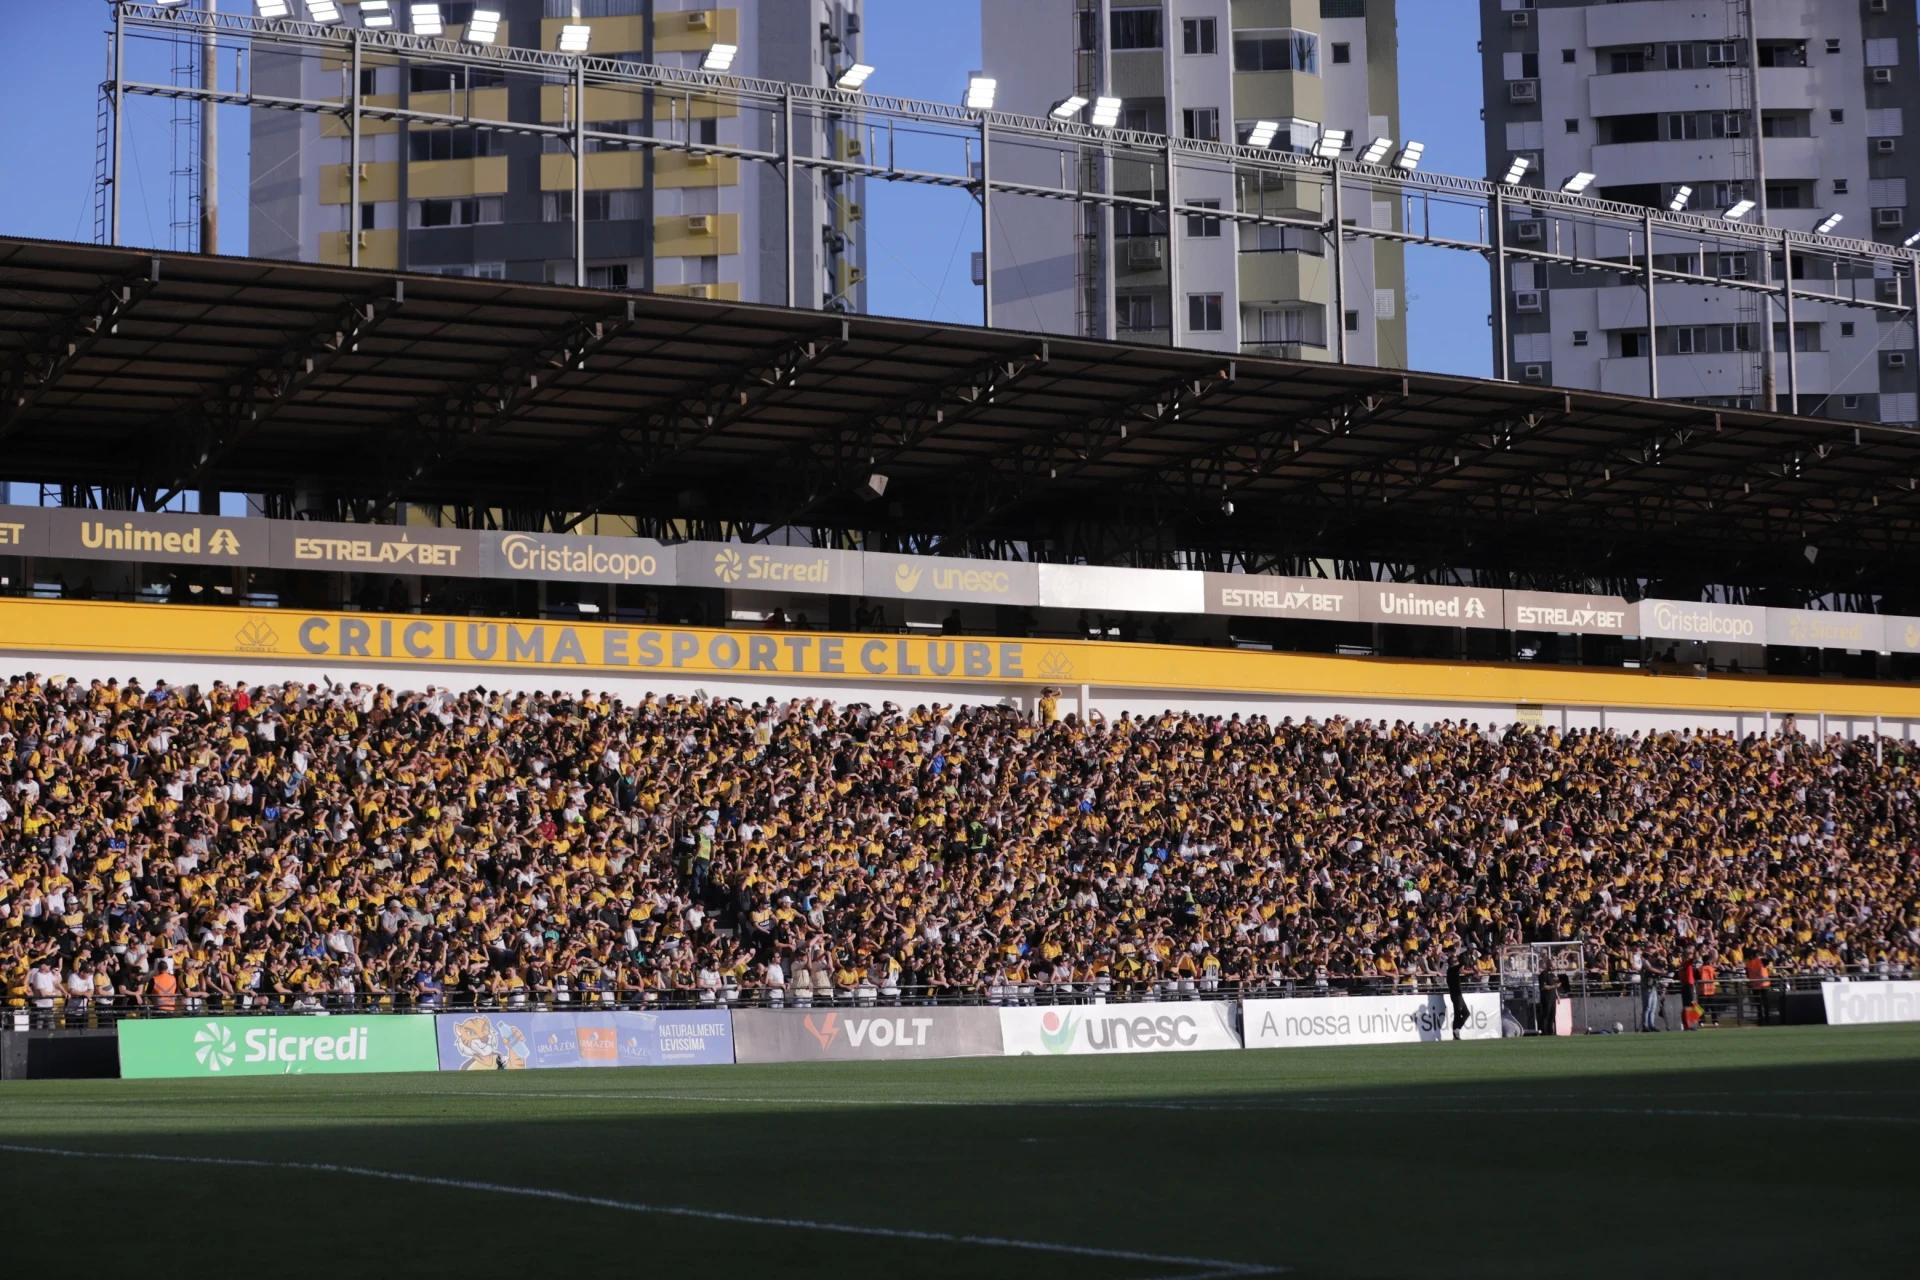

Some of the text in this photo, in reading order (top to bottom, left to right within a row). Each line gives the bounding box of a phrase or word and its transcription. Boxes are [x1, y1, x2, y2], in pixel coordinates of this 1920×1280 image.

[81, 521, 201, 554] Unimed
[506, 541, 657, 580] Cristalcopo
[747, 555, 830, 583] Sicredi
[932, 567, 1009, 593] unesc
[1379, 592, 1460, 618] Unimed
[1658, 606, 1753, 640] Cristalcopo
[298, 616, 1025, 678] CRICIÚMA ESPORTE CLUBE
[1832, 983, 1920, 1024] Fonta
[658, 1023, 725, 1037] NATURALMENTE
[844, 1017, 935, 1048] VOLT
[1086, 1015, 1199, 1049] unesc
[1261, 1004, 1487, 1037] A nossa universidde
[244, 1026, 368, 1062] Sicredi
